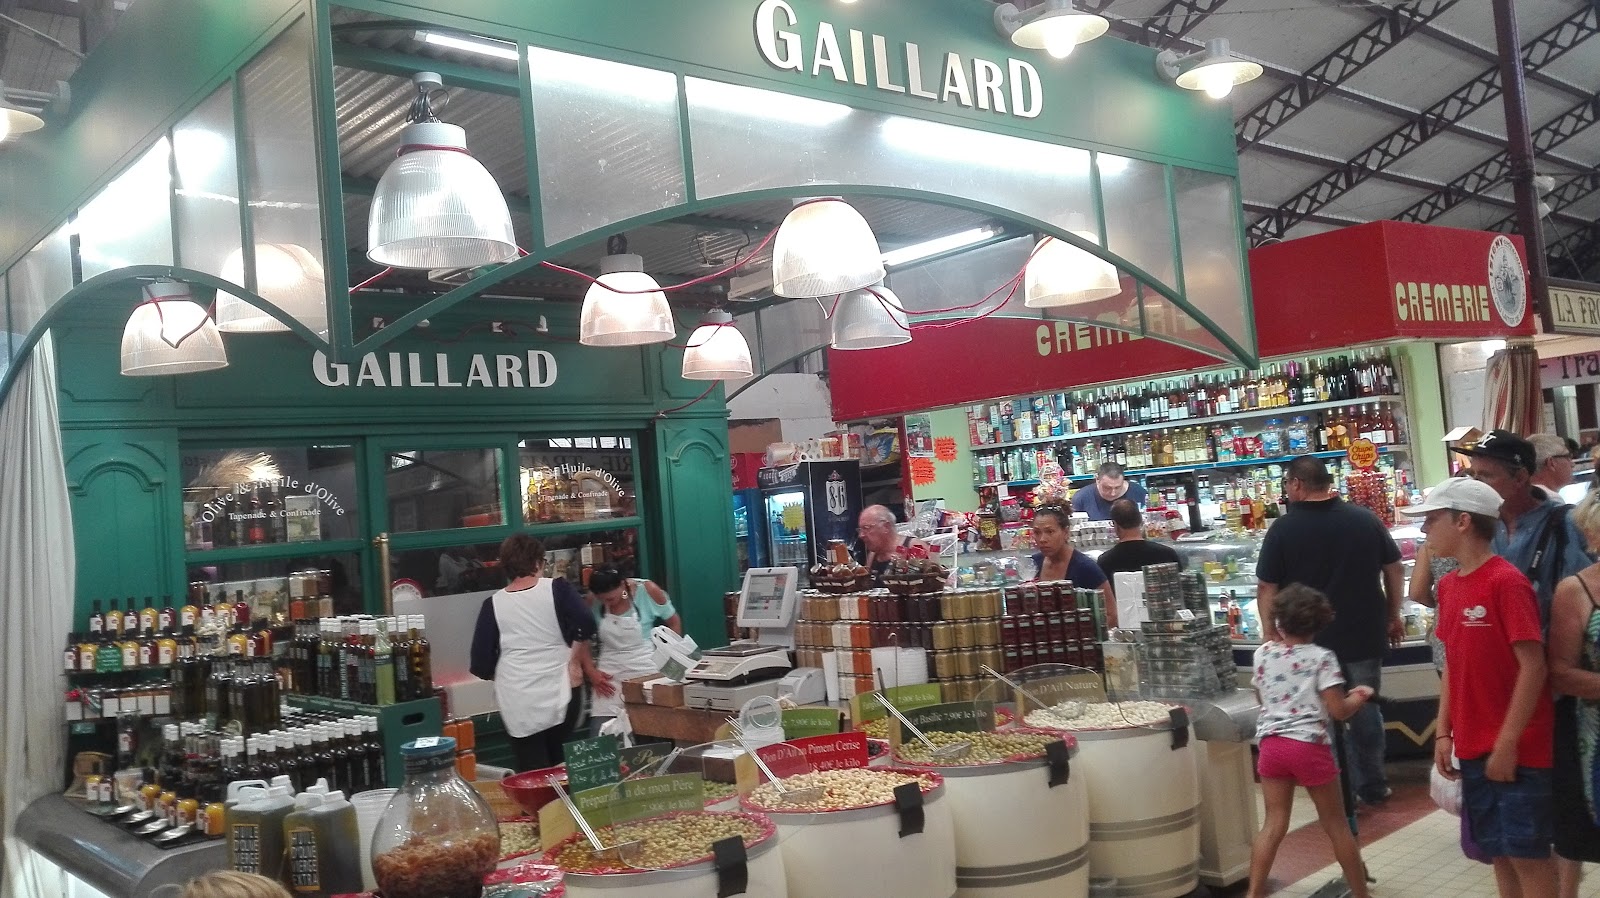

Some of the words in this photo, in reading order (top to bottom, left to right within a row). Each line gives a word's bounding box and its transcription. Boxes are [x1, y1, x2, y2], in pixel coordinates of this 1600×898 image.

[754, 0, 1043, 118] GAILLARD
[1395, 282, 1490, 321] CREMERIE
[1554, 293, 1576, 323] LA
[313, 349, 557, 388] GAILLARD
[1352, 452, 1374, 464] Chups
[560, 461, 592, 475] Huile
[595, 468, 625, 497] d'Olive
[202, 492, 235, 523] Olive
[239, 482, 252, 495] &
[304, 482, 345, 517] d'Olive
[228, 511, 267, 521] Tapenade
[1040, 682, 1063, 695] D'Ail
[1065, 680, 1099, 691] Nature
[818, 719, 832, 727] kilo
[808, 743, 835, 755] Piment
[836, 738, 860, 751] Cerise
[845, 757, 861, 768] kilo
[634, 785, 646, 797] de
[648, 783, 671, 794] mon
[673, 779, 695, 791] Père
